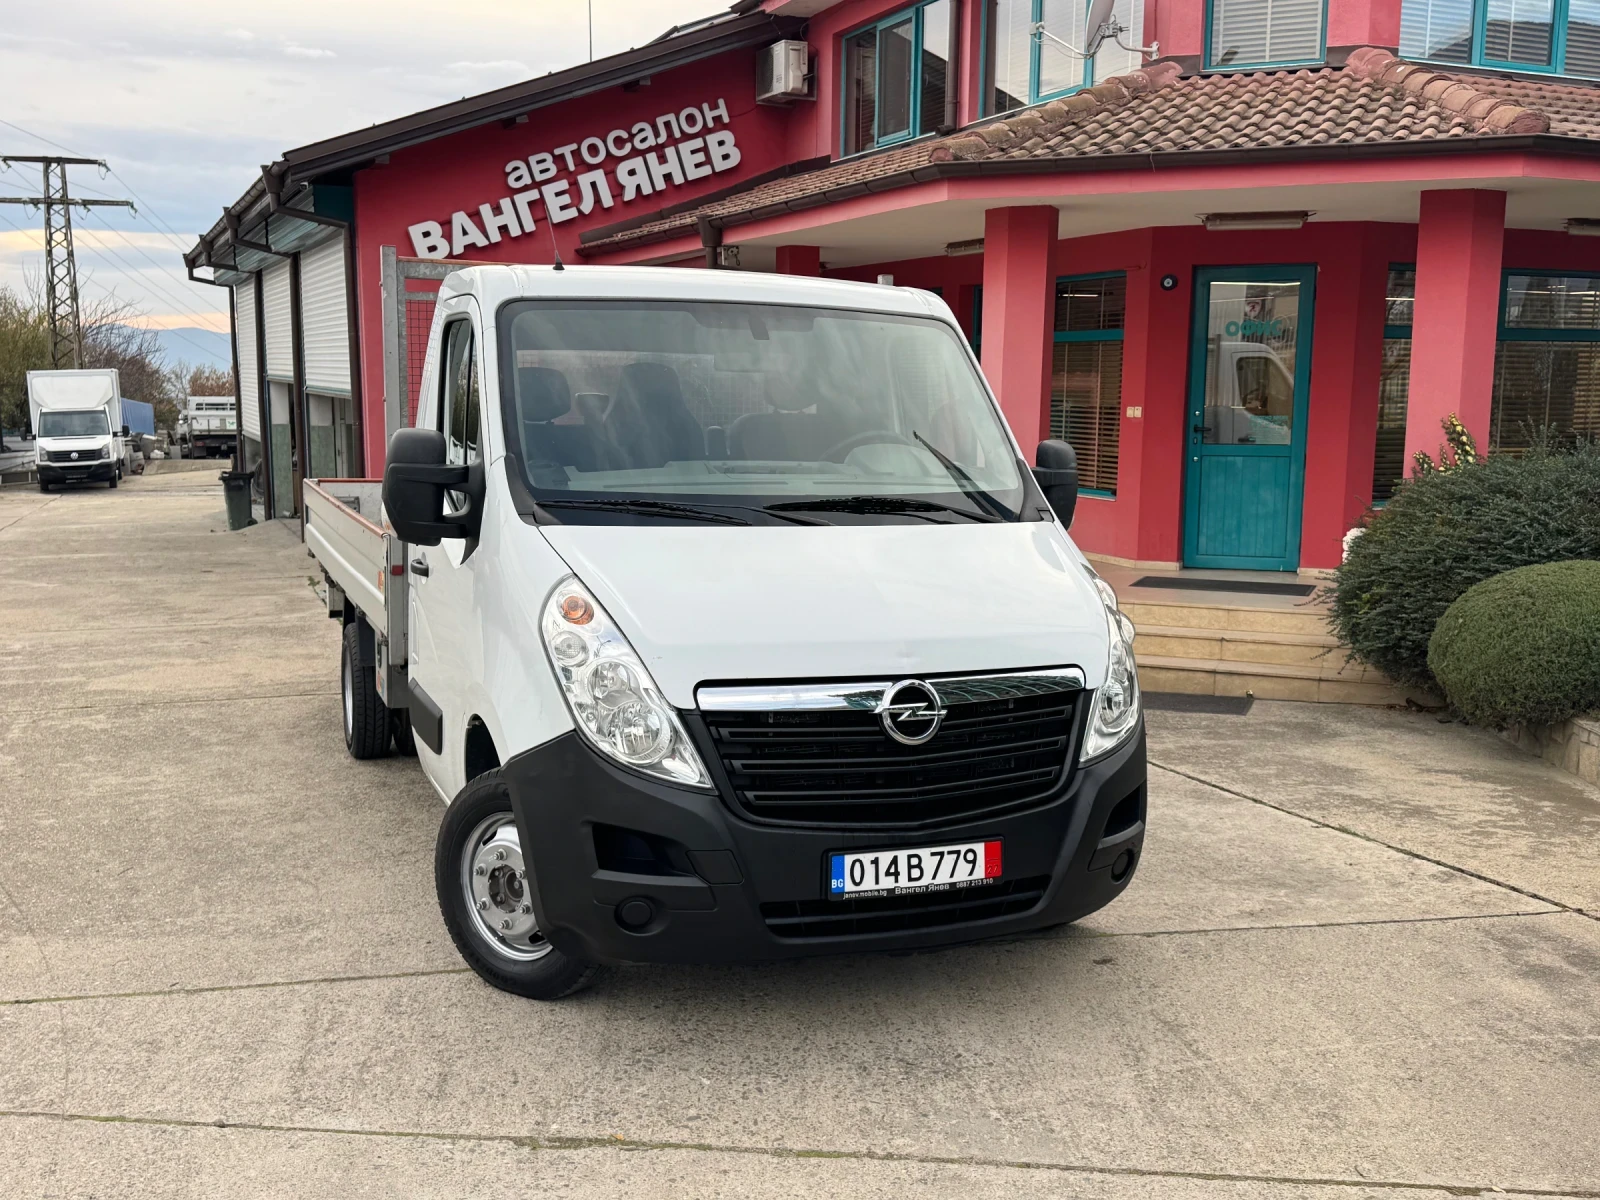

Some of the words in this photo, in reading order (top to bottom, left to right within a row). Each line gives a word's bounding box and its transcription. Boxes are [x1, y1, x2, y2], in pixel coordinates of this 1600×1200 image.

[504, 98, 730, 189] автосалон
[407, 168, 614, 260] ВАНГЕЛ
[615, 130, 742, 202] ЯНЕВ
[1225, 320, 1283, 337] ОФИС
[831, 878, 844, 889] BG
[895, 885, 926, 895] Вангел
[928, 883, 950, 891] Янев
